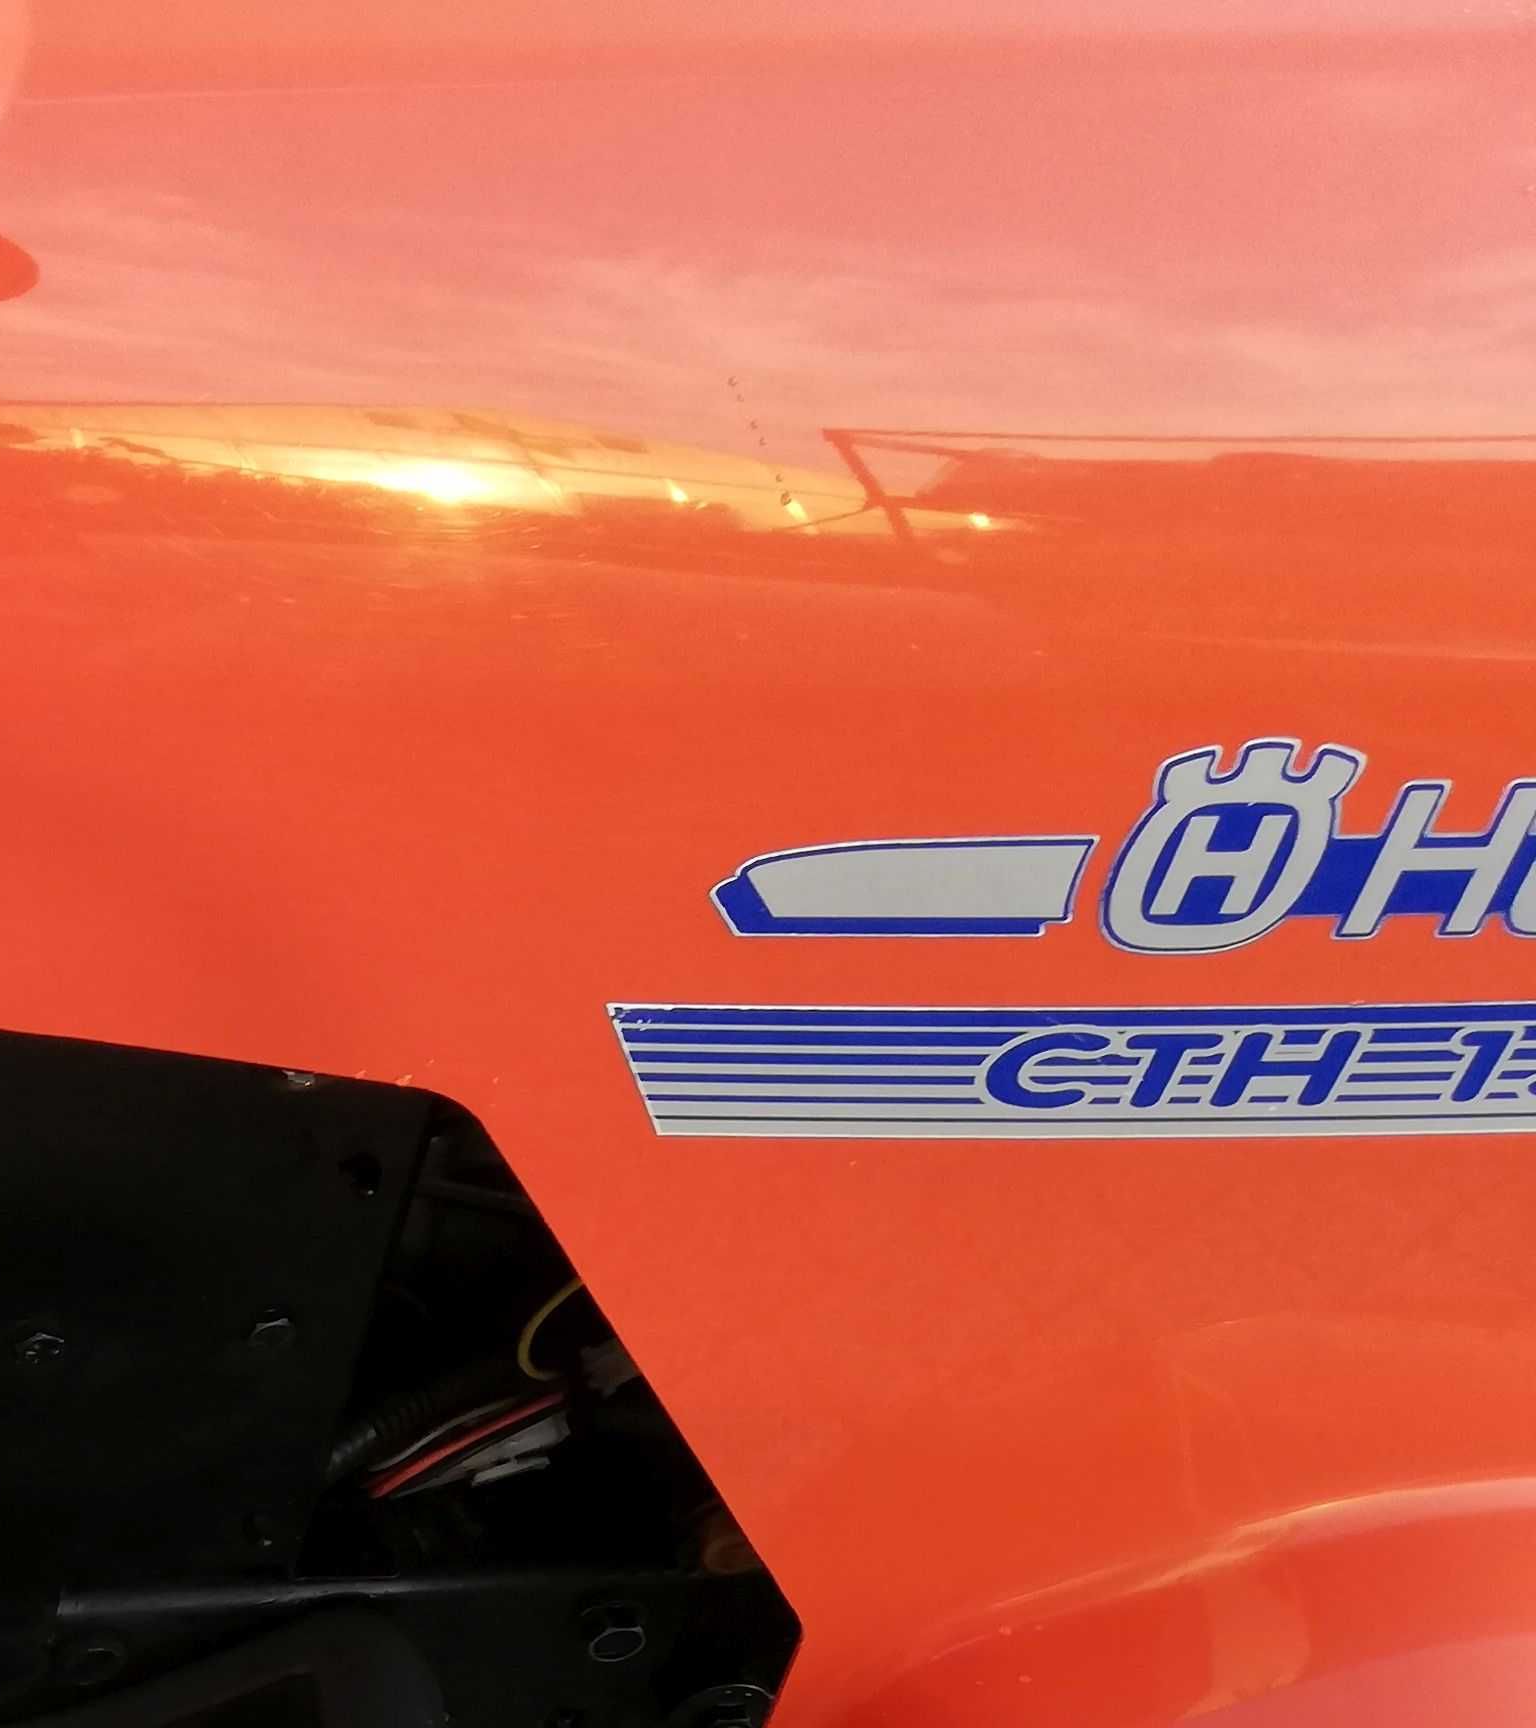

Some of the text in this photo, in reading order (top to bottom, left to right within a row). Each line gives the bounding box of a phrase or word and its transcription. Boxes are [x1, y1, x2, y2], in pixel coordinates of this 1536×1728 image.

[1333, 782, 1536, 936] H
[986, 1029, 1536, 1109] CTH 1
